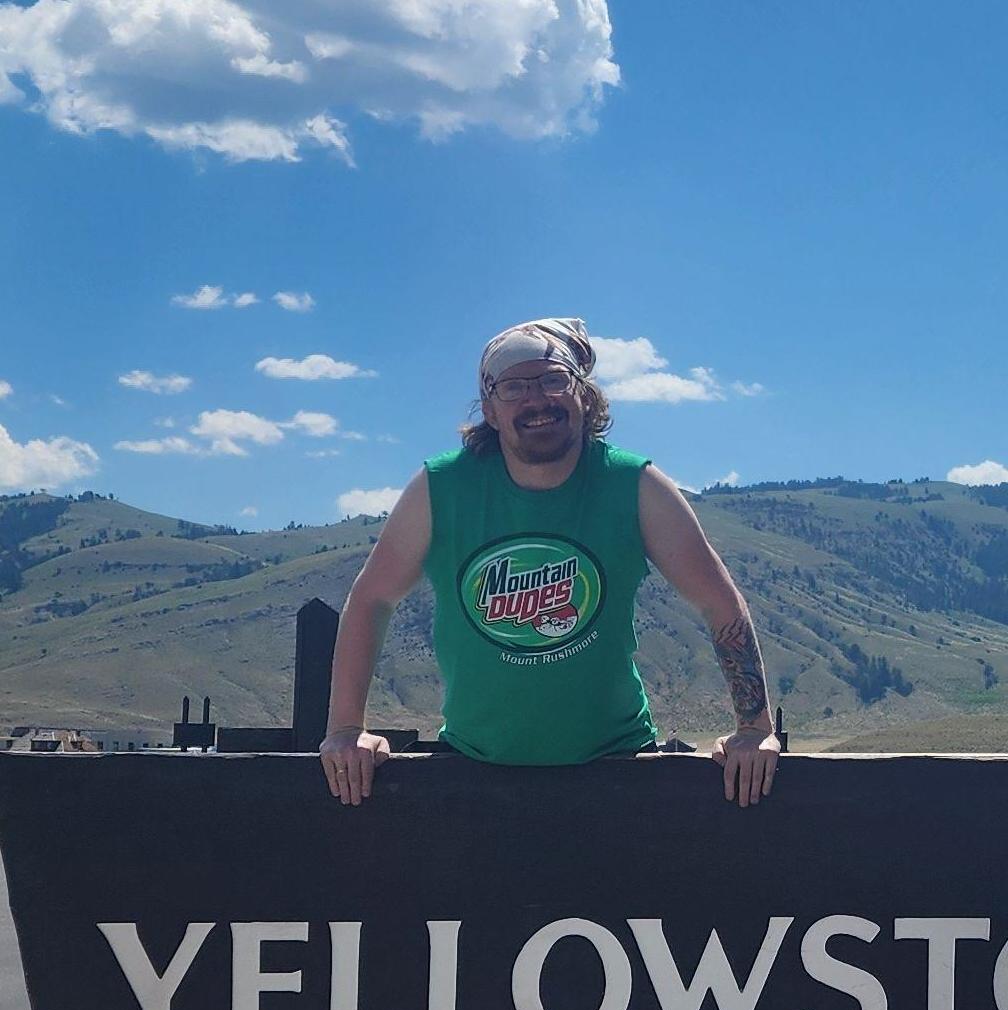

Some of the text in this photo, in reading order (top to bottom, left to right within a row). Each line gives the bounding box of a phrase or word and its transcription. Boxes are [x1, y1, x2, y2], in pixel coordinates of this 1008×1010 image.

[478, 556, 579, 606] Mountain
[500, 630, 599, 665] Mount Rushmore
